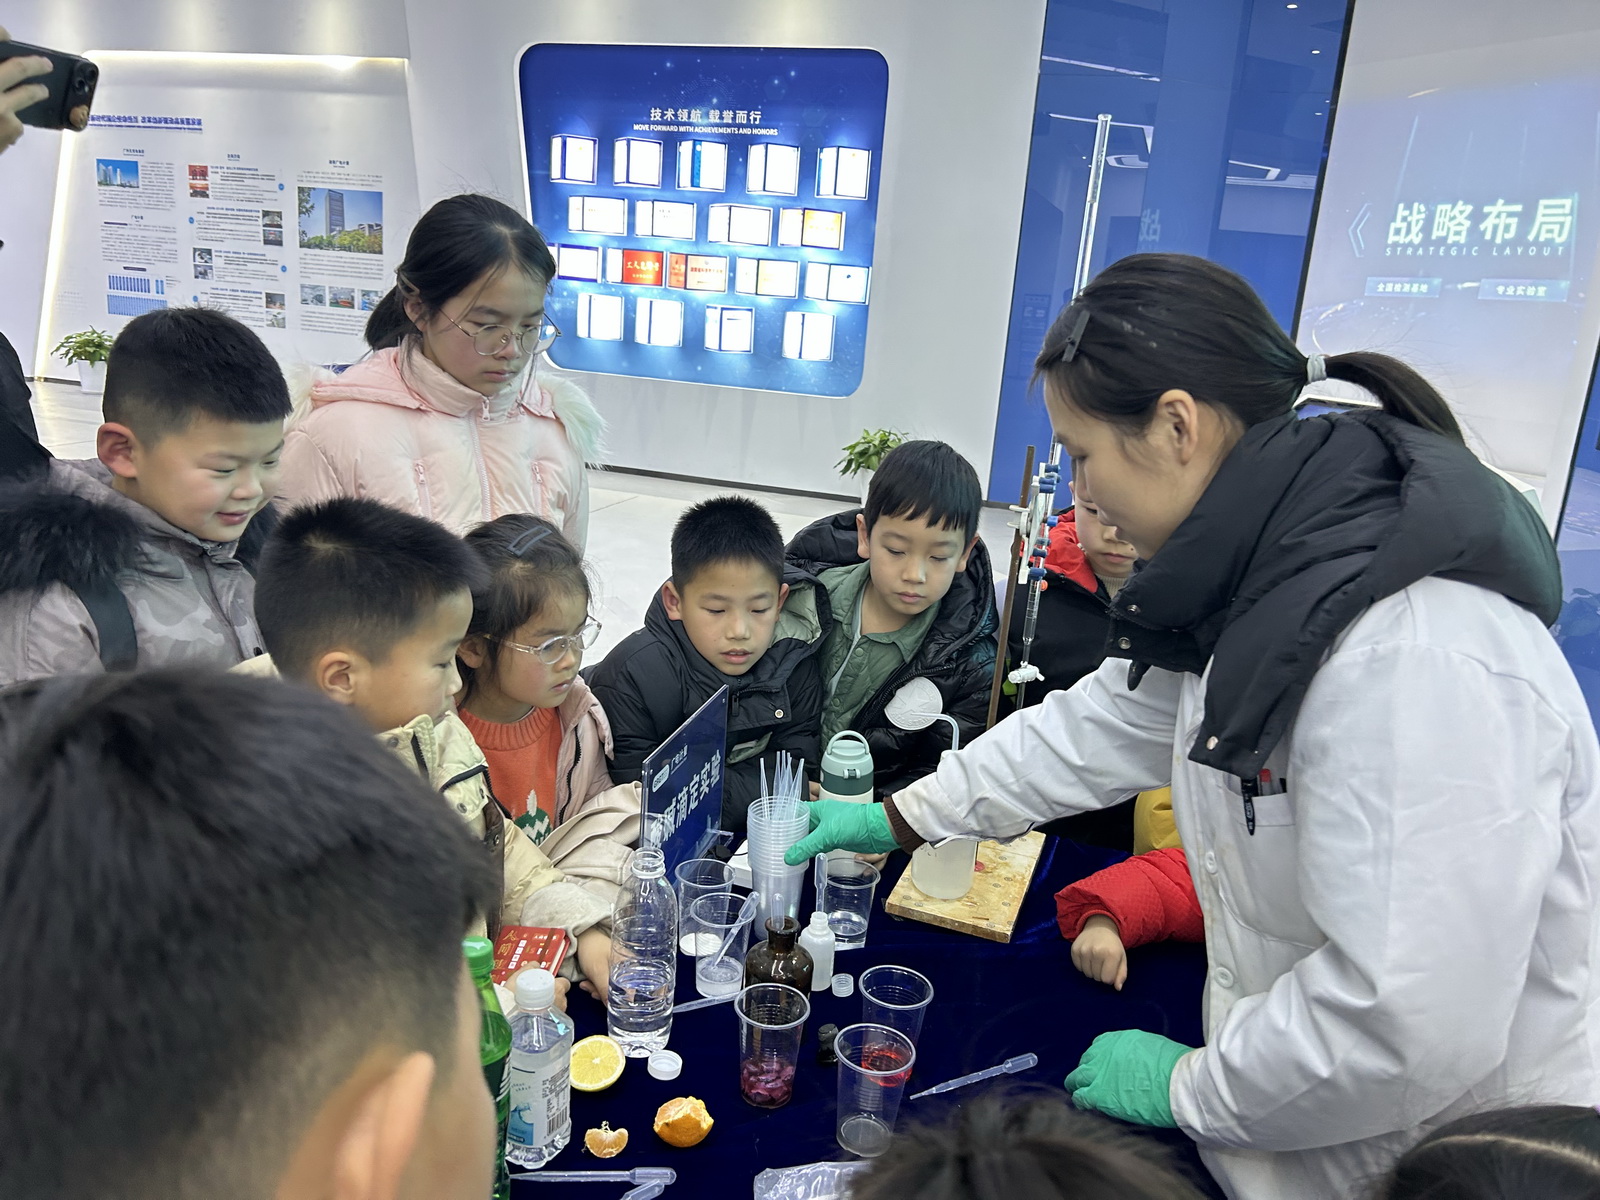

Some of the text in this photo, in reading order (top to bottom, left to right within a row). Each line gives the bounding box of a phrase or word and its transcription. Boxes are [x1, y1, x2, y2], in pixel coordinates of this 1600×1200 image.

[650, 107, 762, 124] 技术领航 载誉而行
[633, 123, 778, 136] MOVE FORWARD WITH ACHIEVEMENTS AND HONORS
[1386, 198, 1573, 245] 战略布局
[1385, 246, 1566, 256] STRATEGIC LAYOUT
